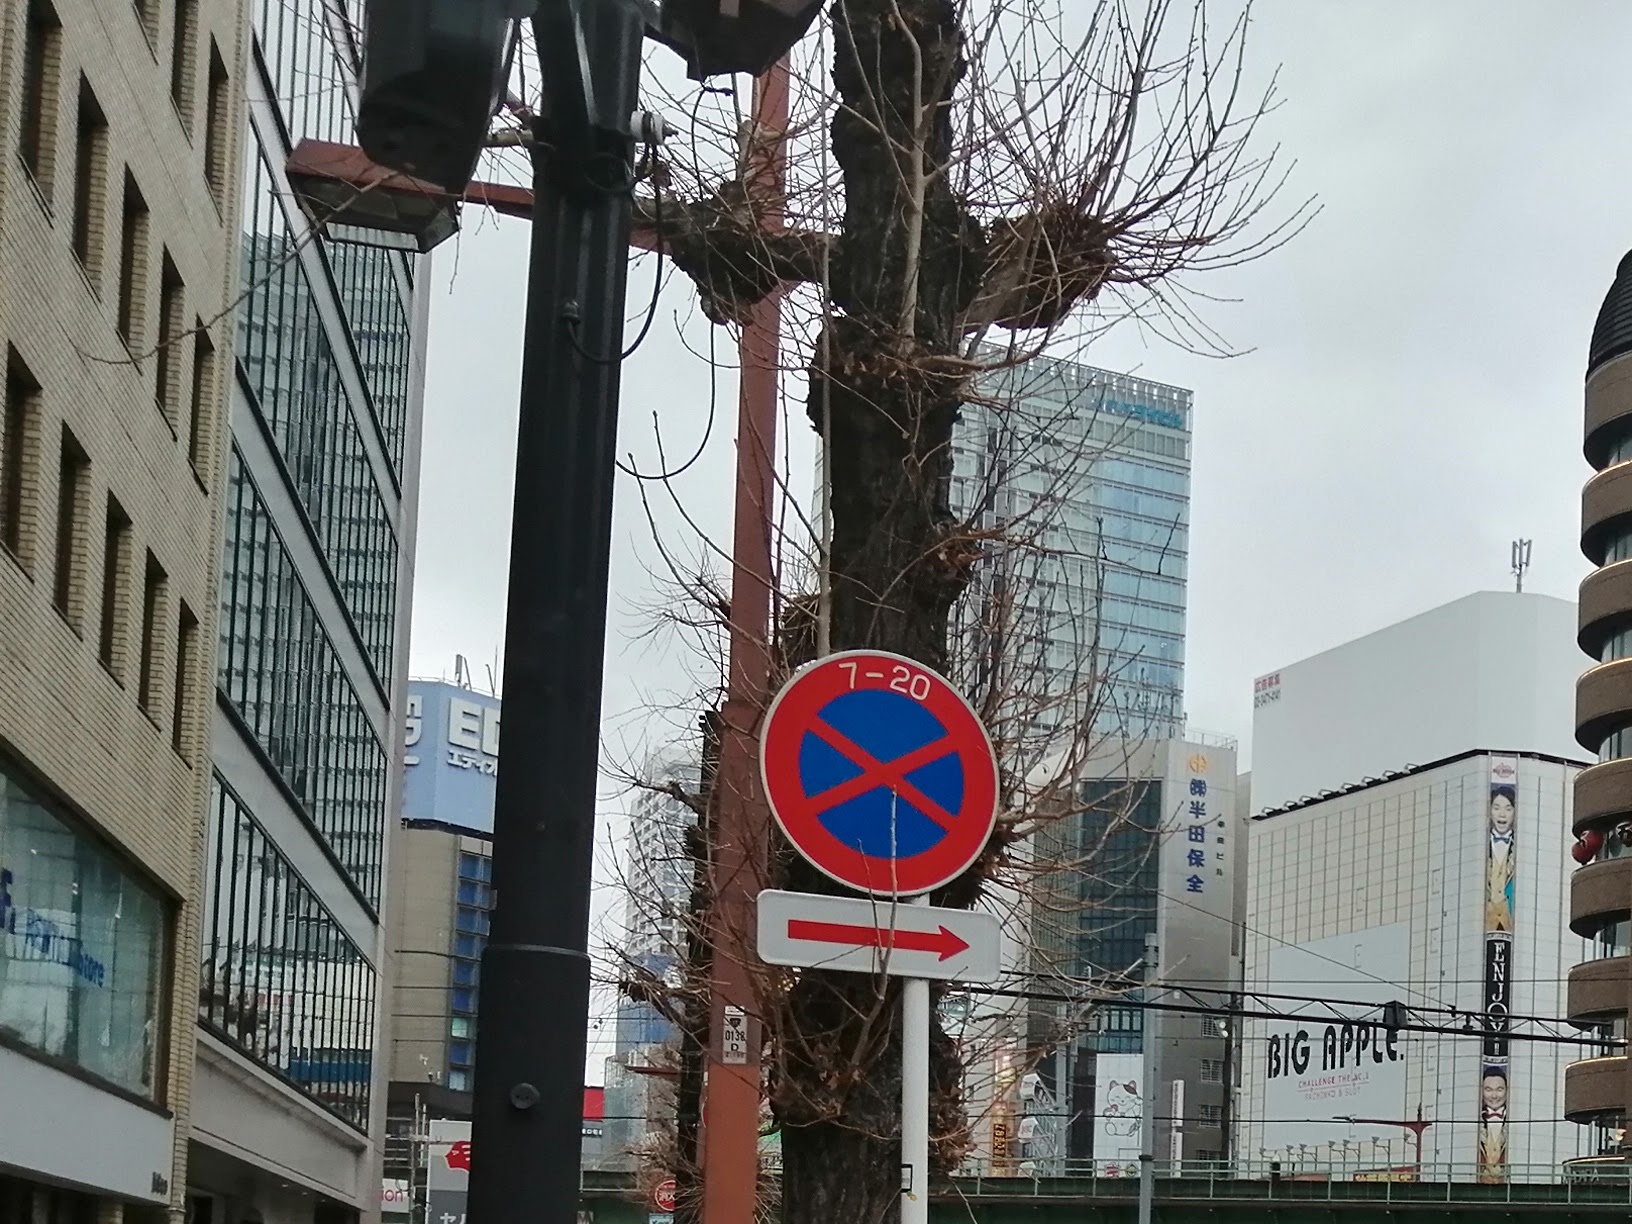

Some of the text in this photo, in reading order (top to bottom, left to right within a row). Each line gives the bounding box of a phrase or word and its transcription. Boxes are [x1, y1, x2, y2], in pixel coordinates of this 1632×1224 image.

[839, 661, 930, 702] 7-20
[731, 1043, 739, 1051] D
[1268, 1029, 1310, 1078] BIG
[1298, 1076, 1335, 1088] CHALLENGE
